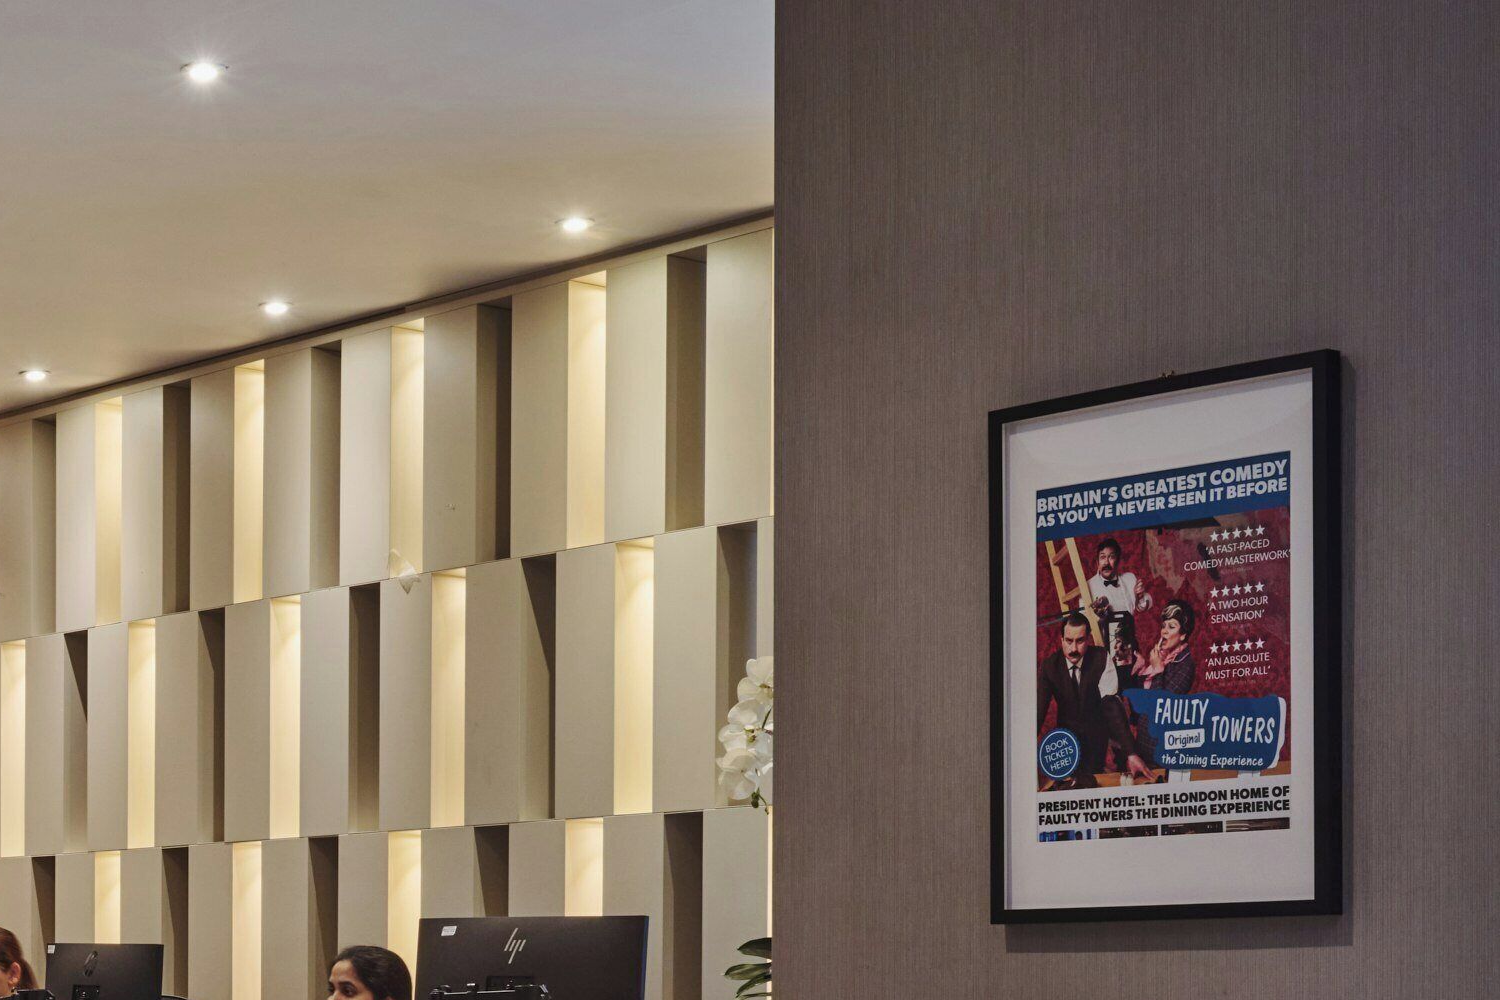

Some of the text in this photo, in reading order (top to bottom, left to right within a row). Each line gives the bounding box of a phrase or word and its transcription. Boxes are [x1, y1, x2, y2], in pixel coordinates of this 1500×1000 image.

[1037, 459, 1288, 513] BRITAIN'S GREATEST COMEDY
[1037, 476, 1288, 529] AS YOU'VE NEVER SEEN IT BEFORE
[1216, 538, 1270, 554] FAST-PACED
[1184, 558, 1224, 572] COMEDY
[1218, 600, 1240, 610] TWO
[1240, 596, 1268, 608] HOUR
[1210, 609, 1265, 624] SENSATION'
[1223, 652, 1270, 666] ABSOLUTE
[1205, 669, 1232, 680] MUST
[1232, 666, 1250, 678] FOR
[1154, 698, 1209, 725] FAULTY
[1212, 716, 1275, 744] TOWERS
[1045, 738, 1068, 753] BOOK
[1168, 732, 1201, 748] Original
[1044, 746, 1074, 764] TICKETS
[1162, 754, 1264, 768] the Dining Experience
[1050, 756, 1072, 772] HERE!
[1038, 786, 1290, 812] PRESIDENT HOTEL: THE LONDON HOME OF
[1038, 800, 1290, 826] FAULTY TOWERS THE DINING EXPERIENCE
